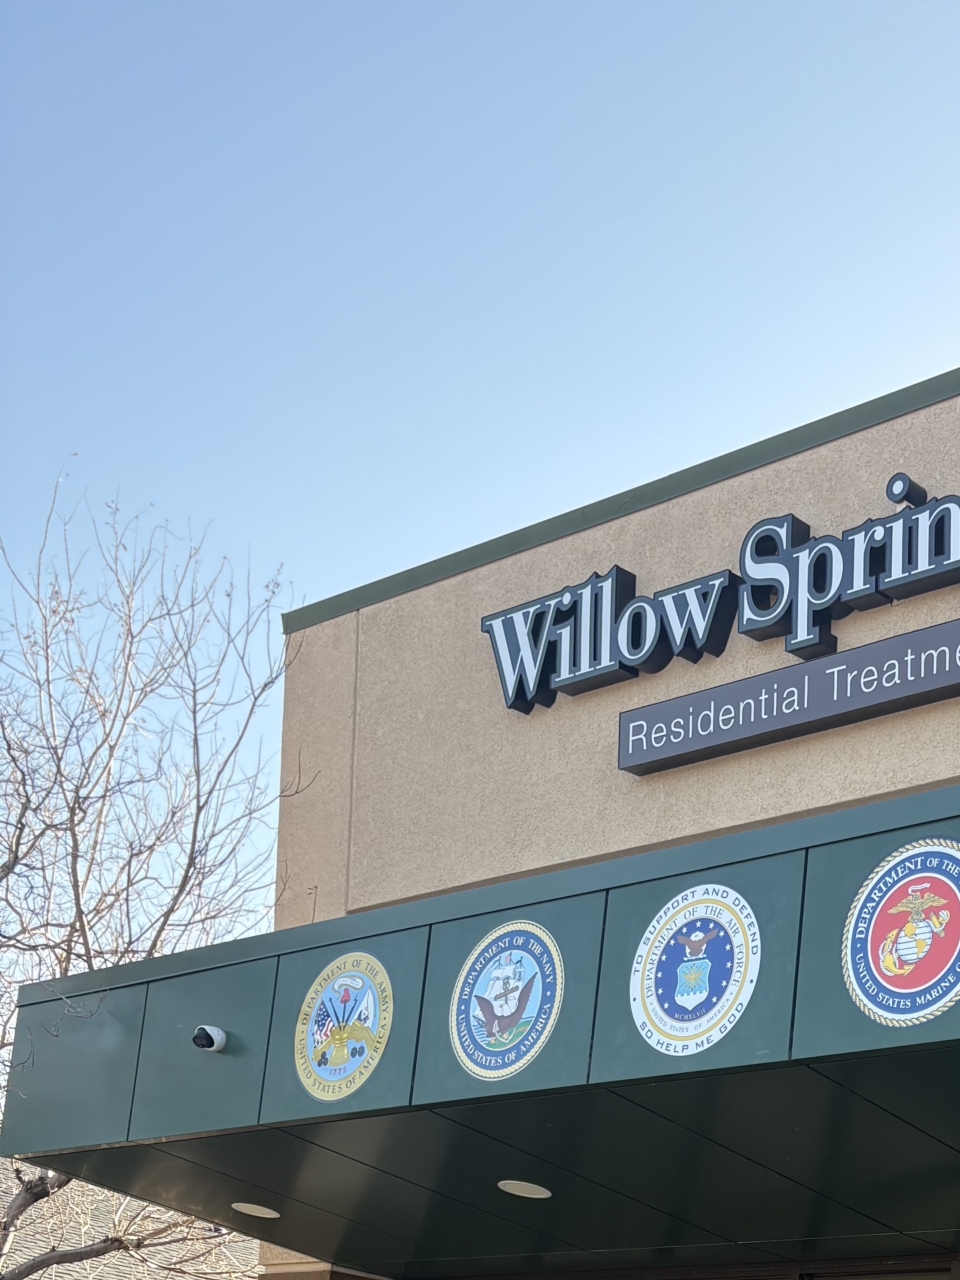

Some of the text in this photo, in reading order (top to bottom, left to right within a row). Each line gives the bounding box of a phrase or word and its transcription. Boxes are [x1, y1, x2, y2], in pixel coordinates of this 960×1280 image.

[483, 572, 728, 703] Willow
[628, 676, 810, 754] Residential
[633, 887, 759, 976] TO SUPPORT AND DEFEND
[855, 857, 925, 939] DEPARTMENT
[926, 858, 940, 868] OF
[942, 859, 960, 877] THE
[462, 935, 554, 1000] DEPARTMENT OF THE NAVY
[645, 905, 745, 999] DEPARTMENT OF THE AIR FORCE
[855, 953, 877, 995] UNITED
[876, 993, 911, 1008] STATES
[916, 973, 956, 1006] MARINE
[301, 961, 348, 1026] DEPARTMENT
[351, 959, 362, 968] OF
[364, 962, 379, 979] THE
[377, 981, 389, 1013] ARMY
[651, 1008, 667, 1027] UNITED
[669, 1023, 689, 1033] STATES
[706, 998, 730, 1024] AMERICA
[298, 1023, 387, 1094] UNITED STATES OF AMERICA
[458, 1003, 551, 1067] UNITED STATES OF AMERICA
[639, 1002, 744, 1053] SO HELP ME GOD
[329, 1068, 347, 1077] 1775
